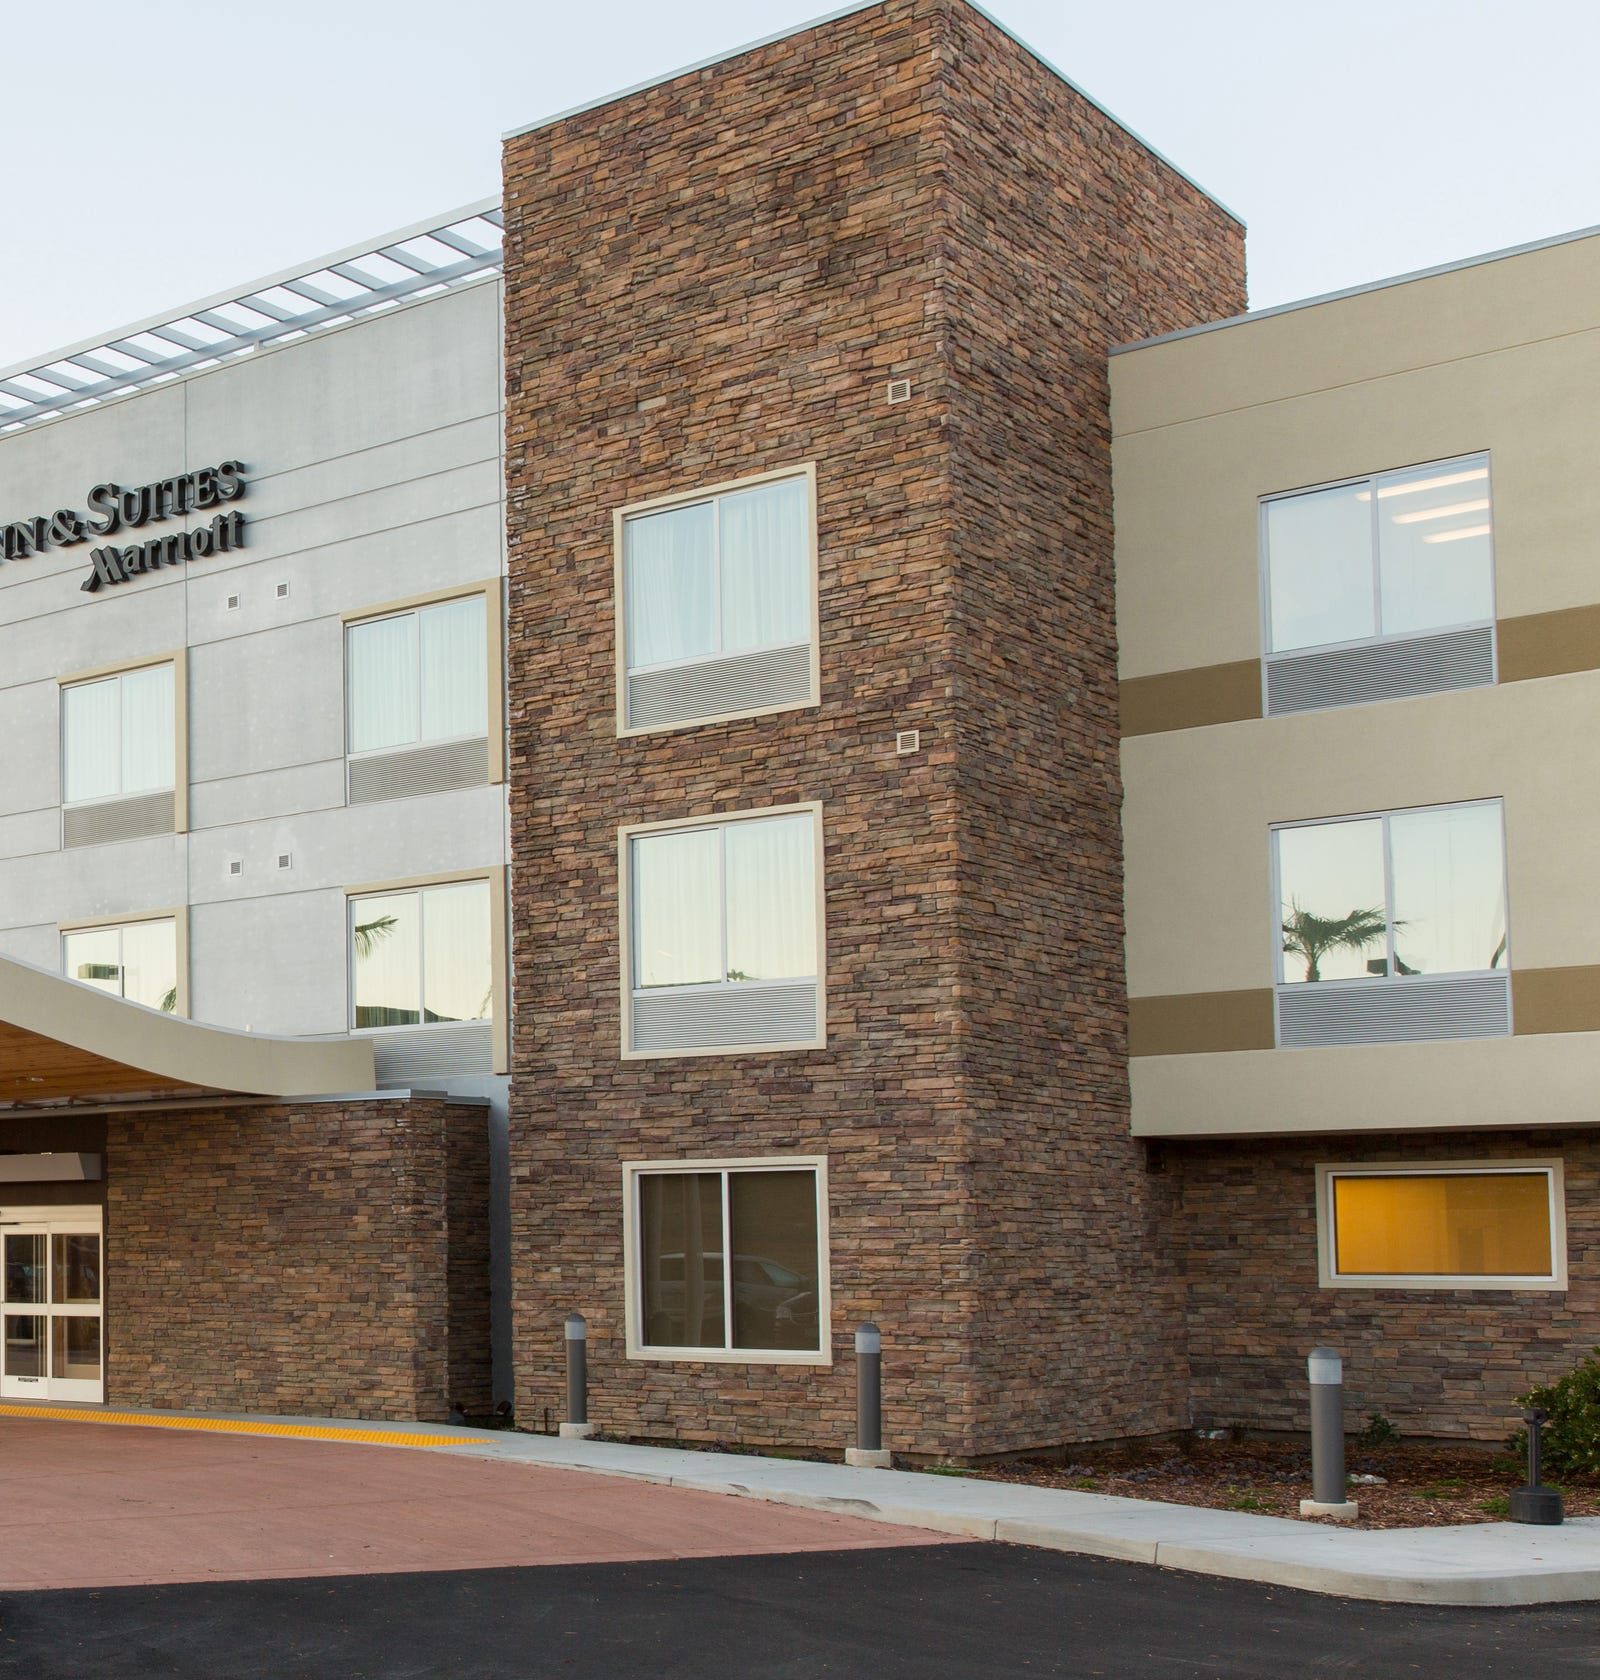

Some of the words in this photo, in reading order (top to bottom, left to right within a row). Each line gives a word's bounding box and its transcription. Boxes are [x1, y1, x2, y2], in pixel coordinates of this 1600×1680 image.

[47, 508, 89, 547] &
[86, 460, 247, 536] SUITES
[81, 510, 247, 592] Marriott
